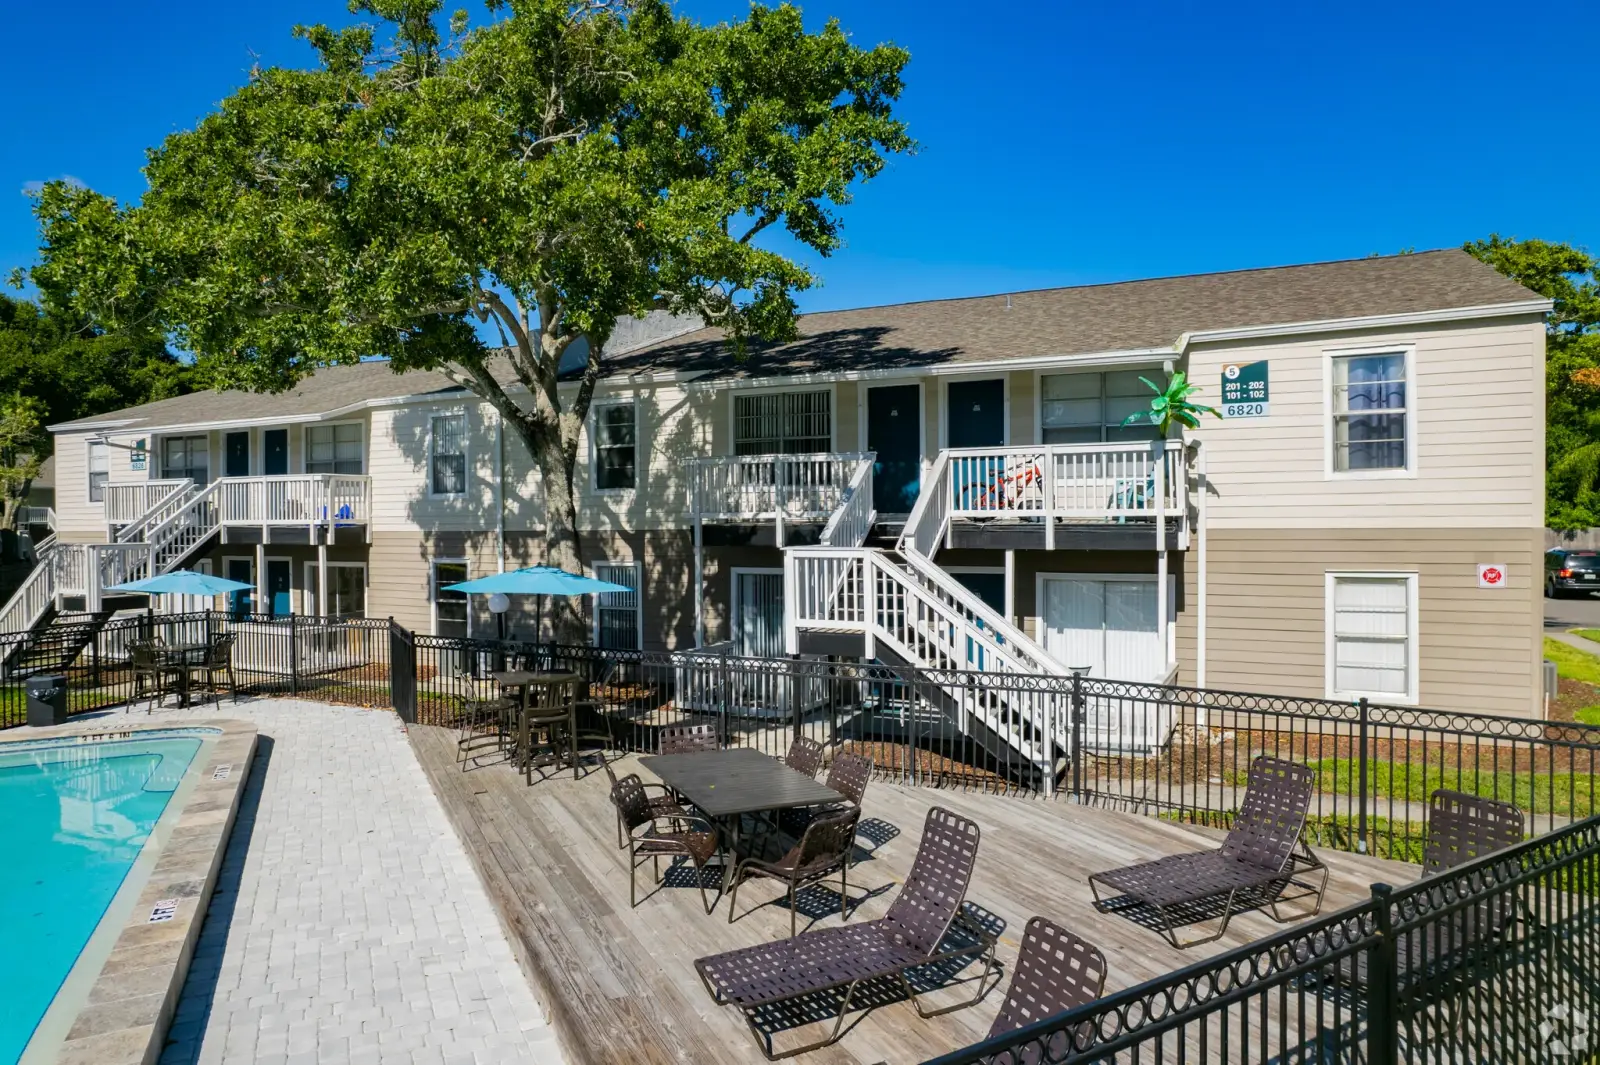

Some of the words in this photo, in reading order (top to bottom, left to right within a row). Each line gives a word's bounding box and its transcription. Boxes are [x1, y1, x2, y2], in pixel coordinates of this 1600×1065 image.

[1229, 368, 1236, 376] 5
[1248, 381, 1264, 390] 202
[1249, 390, 1264, 398] 102
[1228, 404, 1262, 416] 6820
